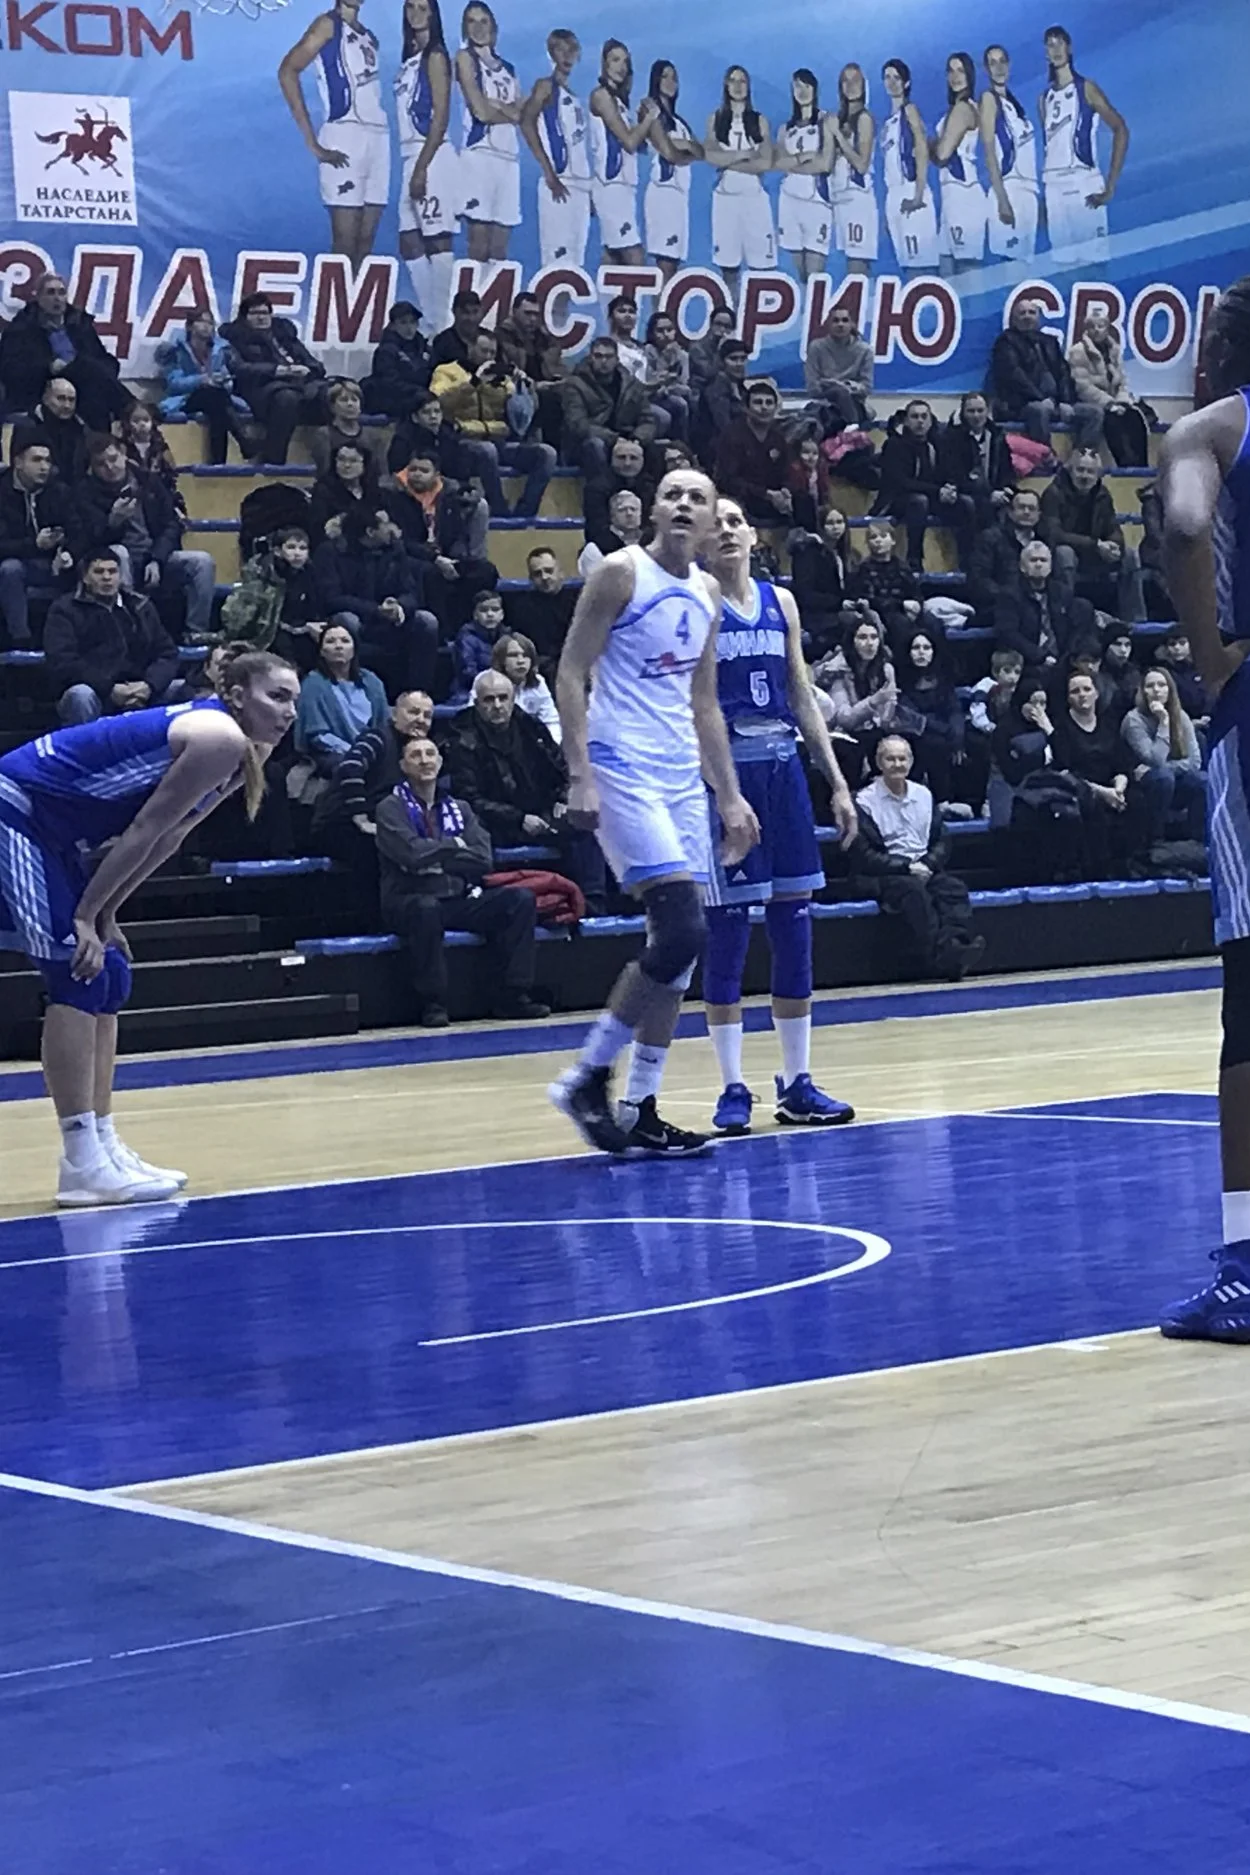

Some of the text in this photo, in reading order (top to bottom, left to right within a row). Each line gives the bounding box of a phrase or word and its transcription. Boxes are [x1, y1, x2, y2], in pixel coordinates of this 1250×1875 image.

[0, 0, 194, 61] КОМ
[36, 187, 131, 203] НАСЛЕДИЕ
[20, 204, 133, 221] ТАТАРСТАНА
[848, 222, 863, 243] 10
[905, 235, 918, 255] 11
[675, 610, 690, 645] 4
[750, 671, 770, 707] 5
